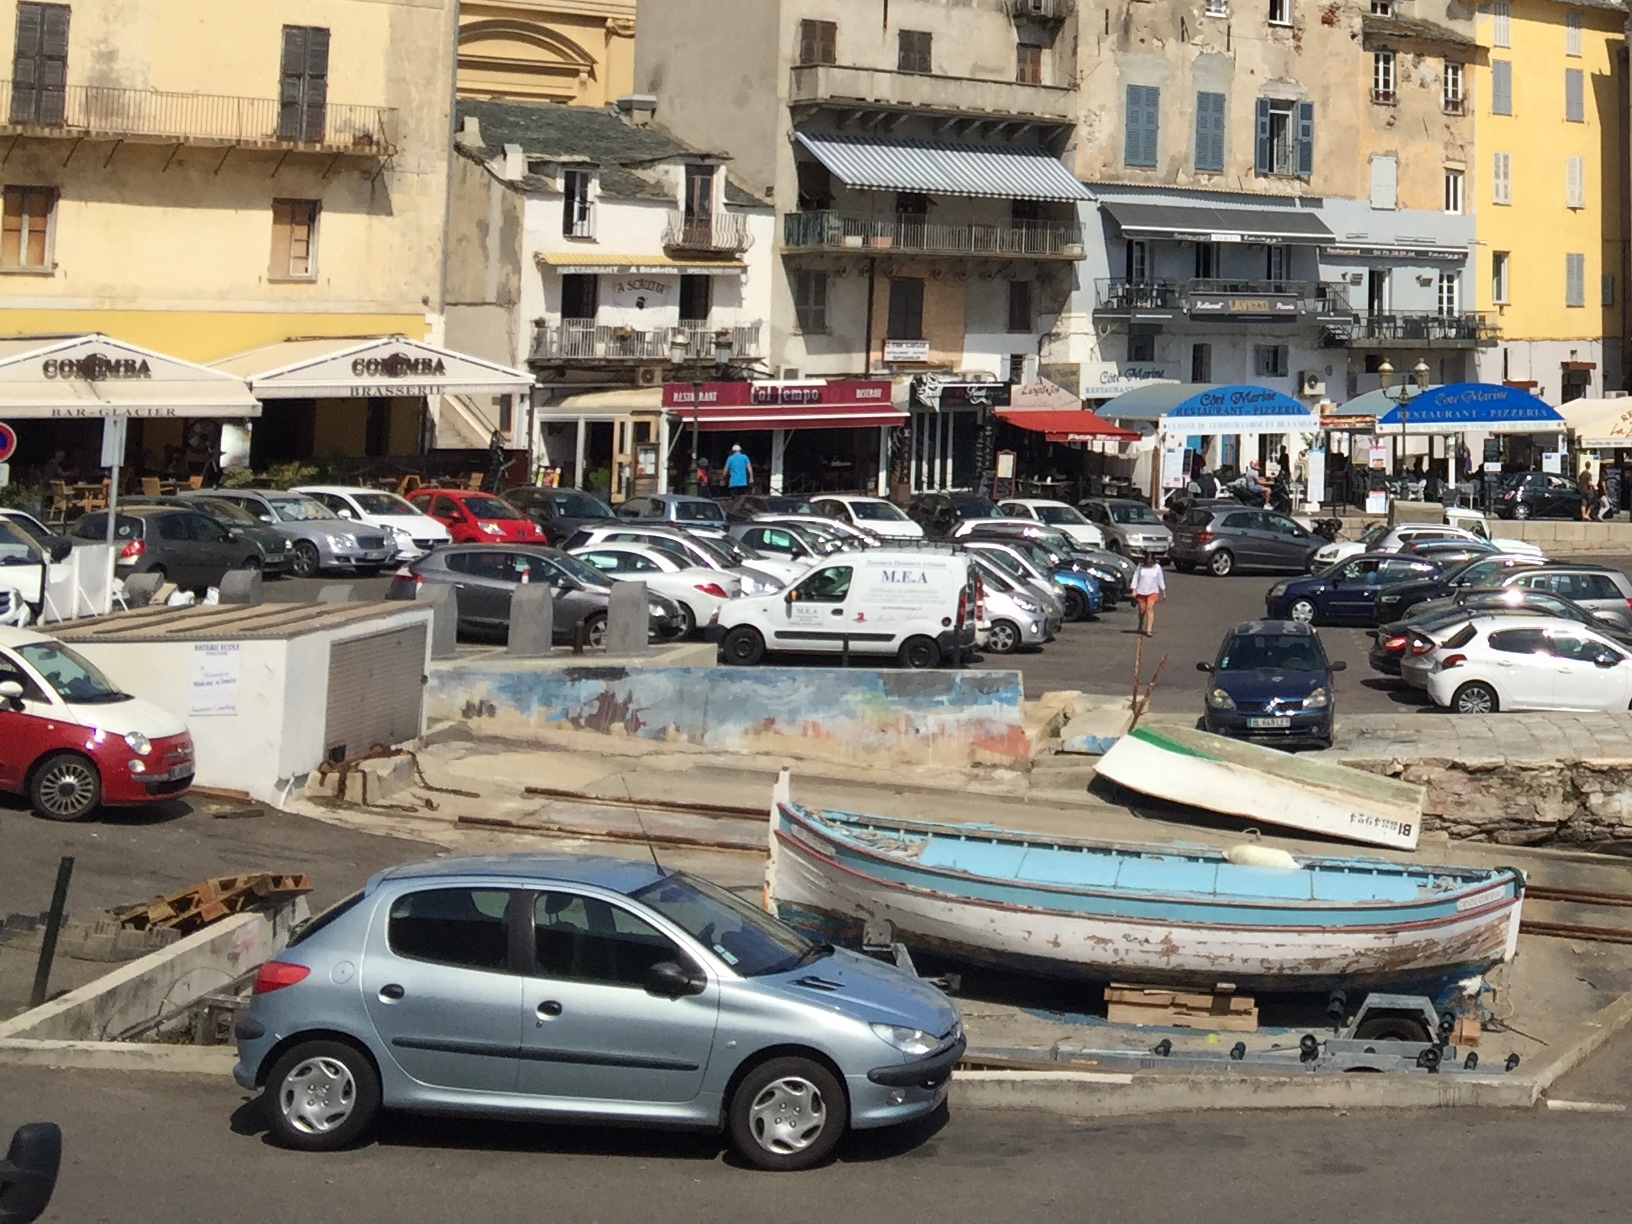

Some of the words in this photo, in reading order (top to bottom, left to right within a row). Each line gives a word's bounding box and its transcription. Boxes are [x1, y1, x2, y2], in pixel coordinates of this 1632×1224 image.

[557, 266, 619, 275] RESTAURANT
[629, 266, 638, 274] A
[1124, 367, 1165, 381] Marine
[350, 386, 445, 397] BRASSERIE
[776, 385, 819, 405] Tempo
[1462, 389, 1509, 403] Marine
[1230, 391, 1277, 405] Marine
[51, 407, 177, 418] BAR-GLACIER
[1176, 406, 1244, 416] RESTAURANT
[1253, 406, 1303, 416] PIZZERIA
[1396, 409, 1478, 419] RESTAURANT
[1490, 408, 1547, 418] PIZZERIA
